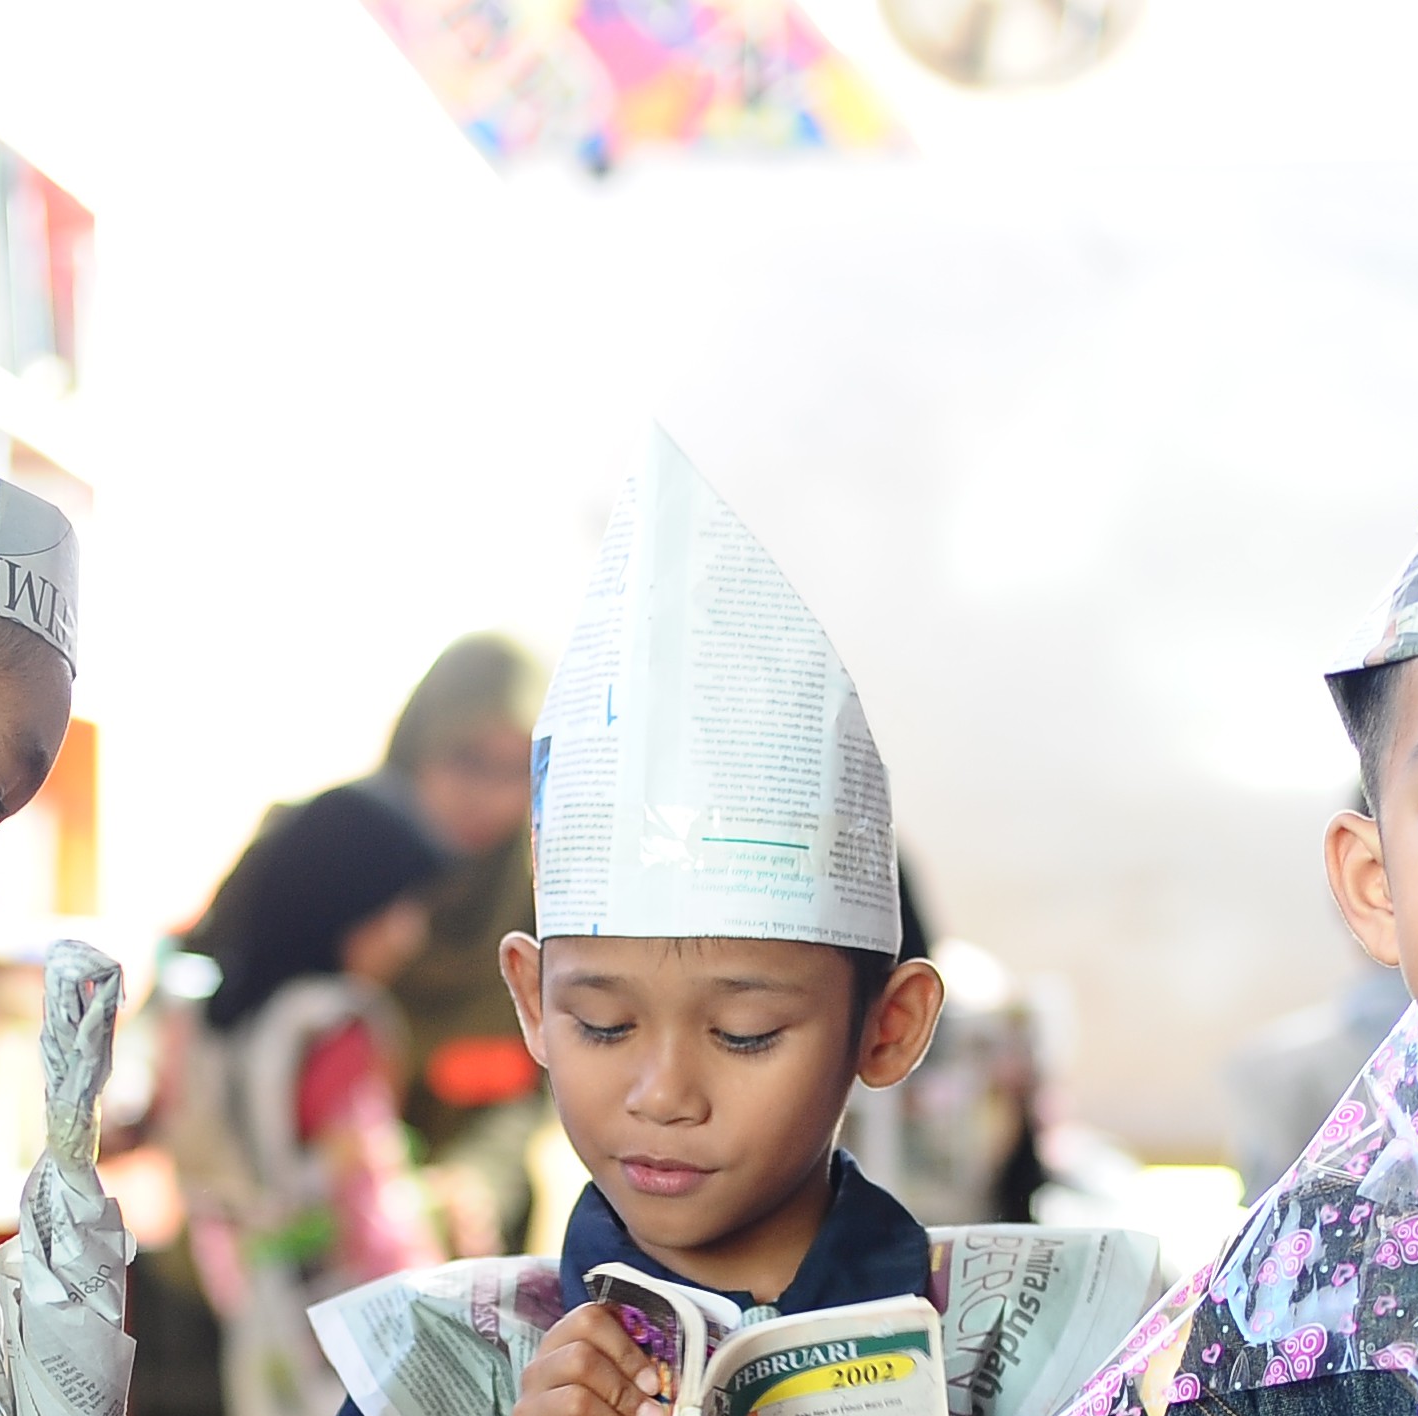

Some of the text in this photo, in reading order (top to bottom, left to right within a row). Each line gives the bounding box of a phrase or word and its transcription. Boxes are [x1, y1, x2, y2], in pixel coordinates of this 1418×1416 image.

[971, 1237, 1062, 1401] Amira sudah
[732, 1340, 859, 1391] FEBRUARI
[828, 1358, 897, 1392] 2002
